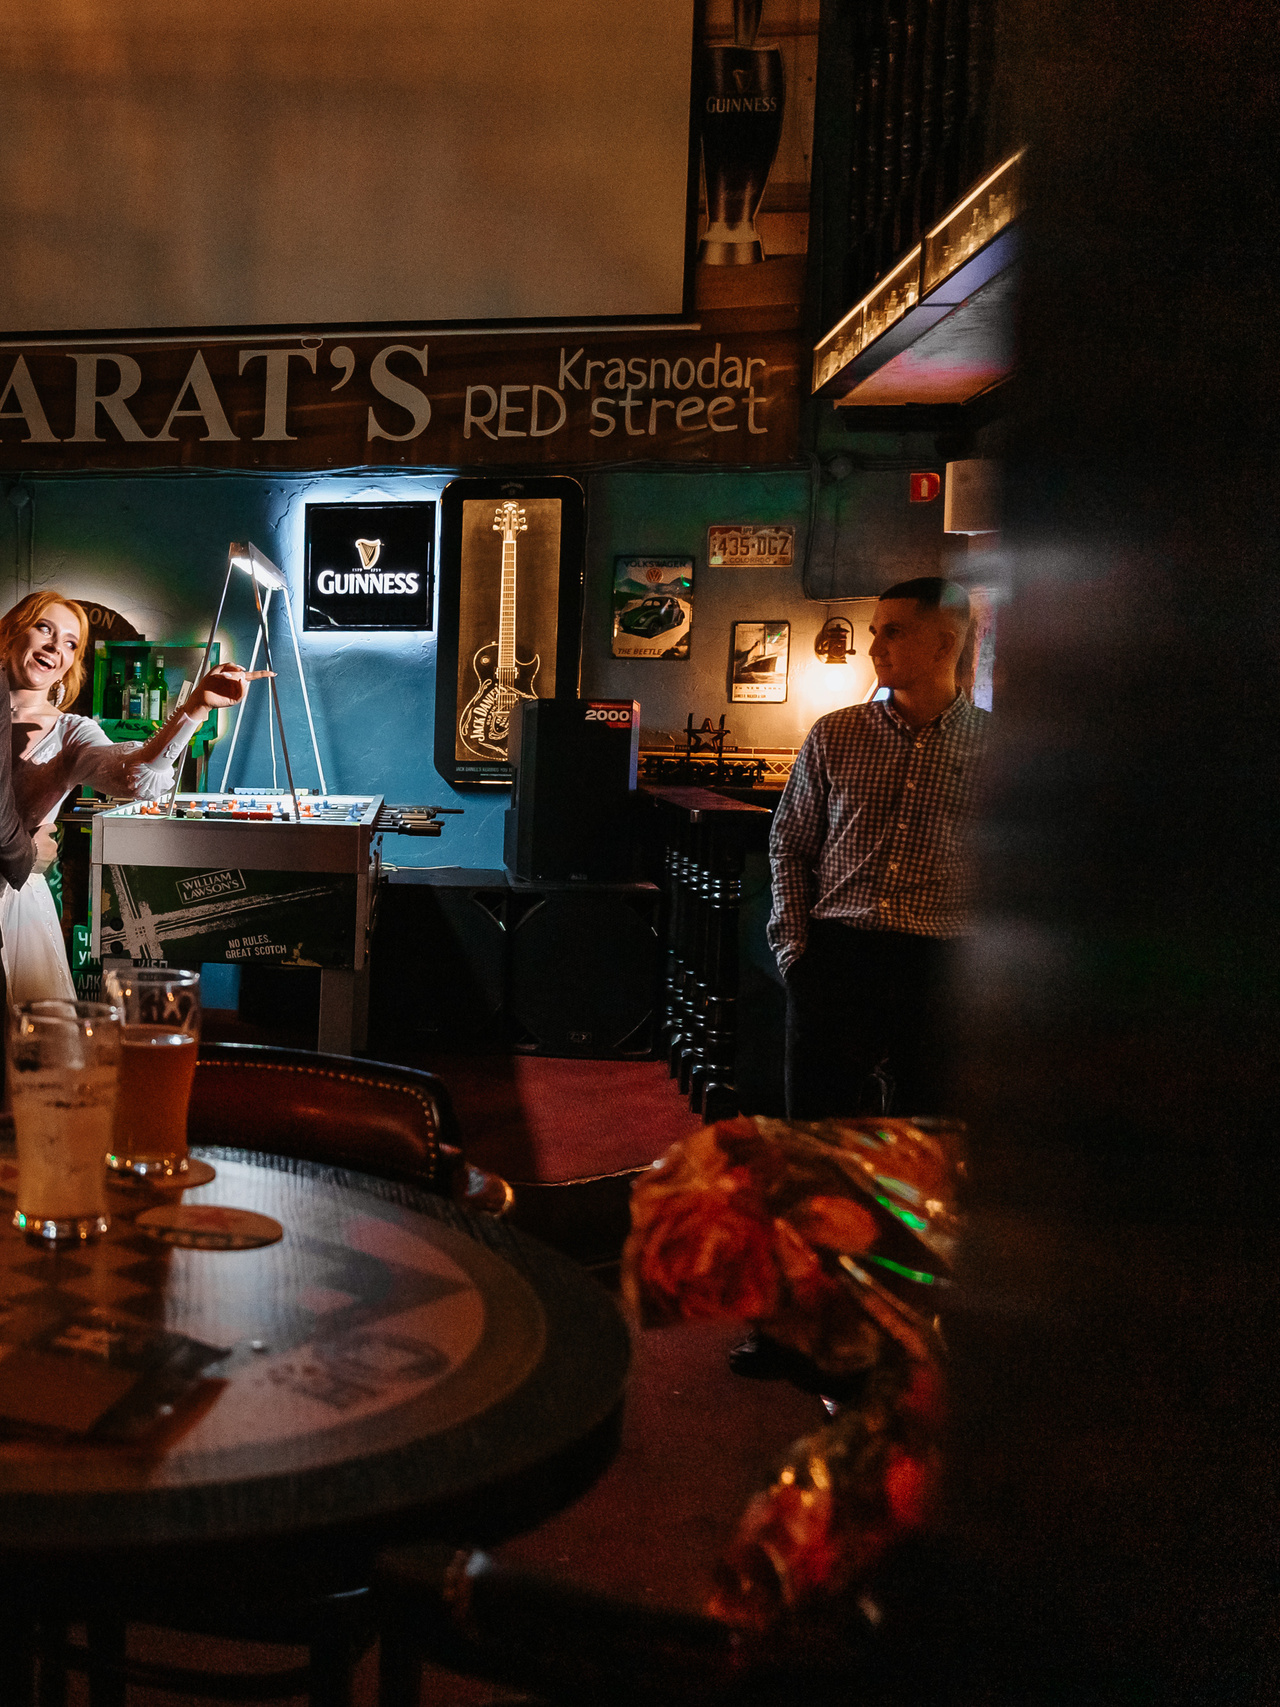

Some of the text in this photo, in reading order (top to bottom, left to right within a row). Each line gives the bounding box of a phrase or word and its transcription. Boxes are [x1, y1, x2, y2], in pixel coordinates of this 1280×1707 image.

[706, 96, 777, 114] GUINNESS
[558, 342, 766, 391] Krasnodar
[463, 384, 768, 441] RED street
[624, 560, 686, 568] VOLKSWAGEN
[317, 569, 420, 595] GUINNESS
[81, 605, 117, 629] ON
[584, 709, 630, 722] 2000
[470, 716, 486, 742] JACK
[182, 872, 232, 891] WILLIAM
[183, 879, 240, 901] LAWSON'S
[228, 933, 272, 949] NO RULES.
[225, 945, 287, 960] GREAT SCOTCH
